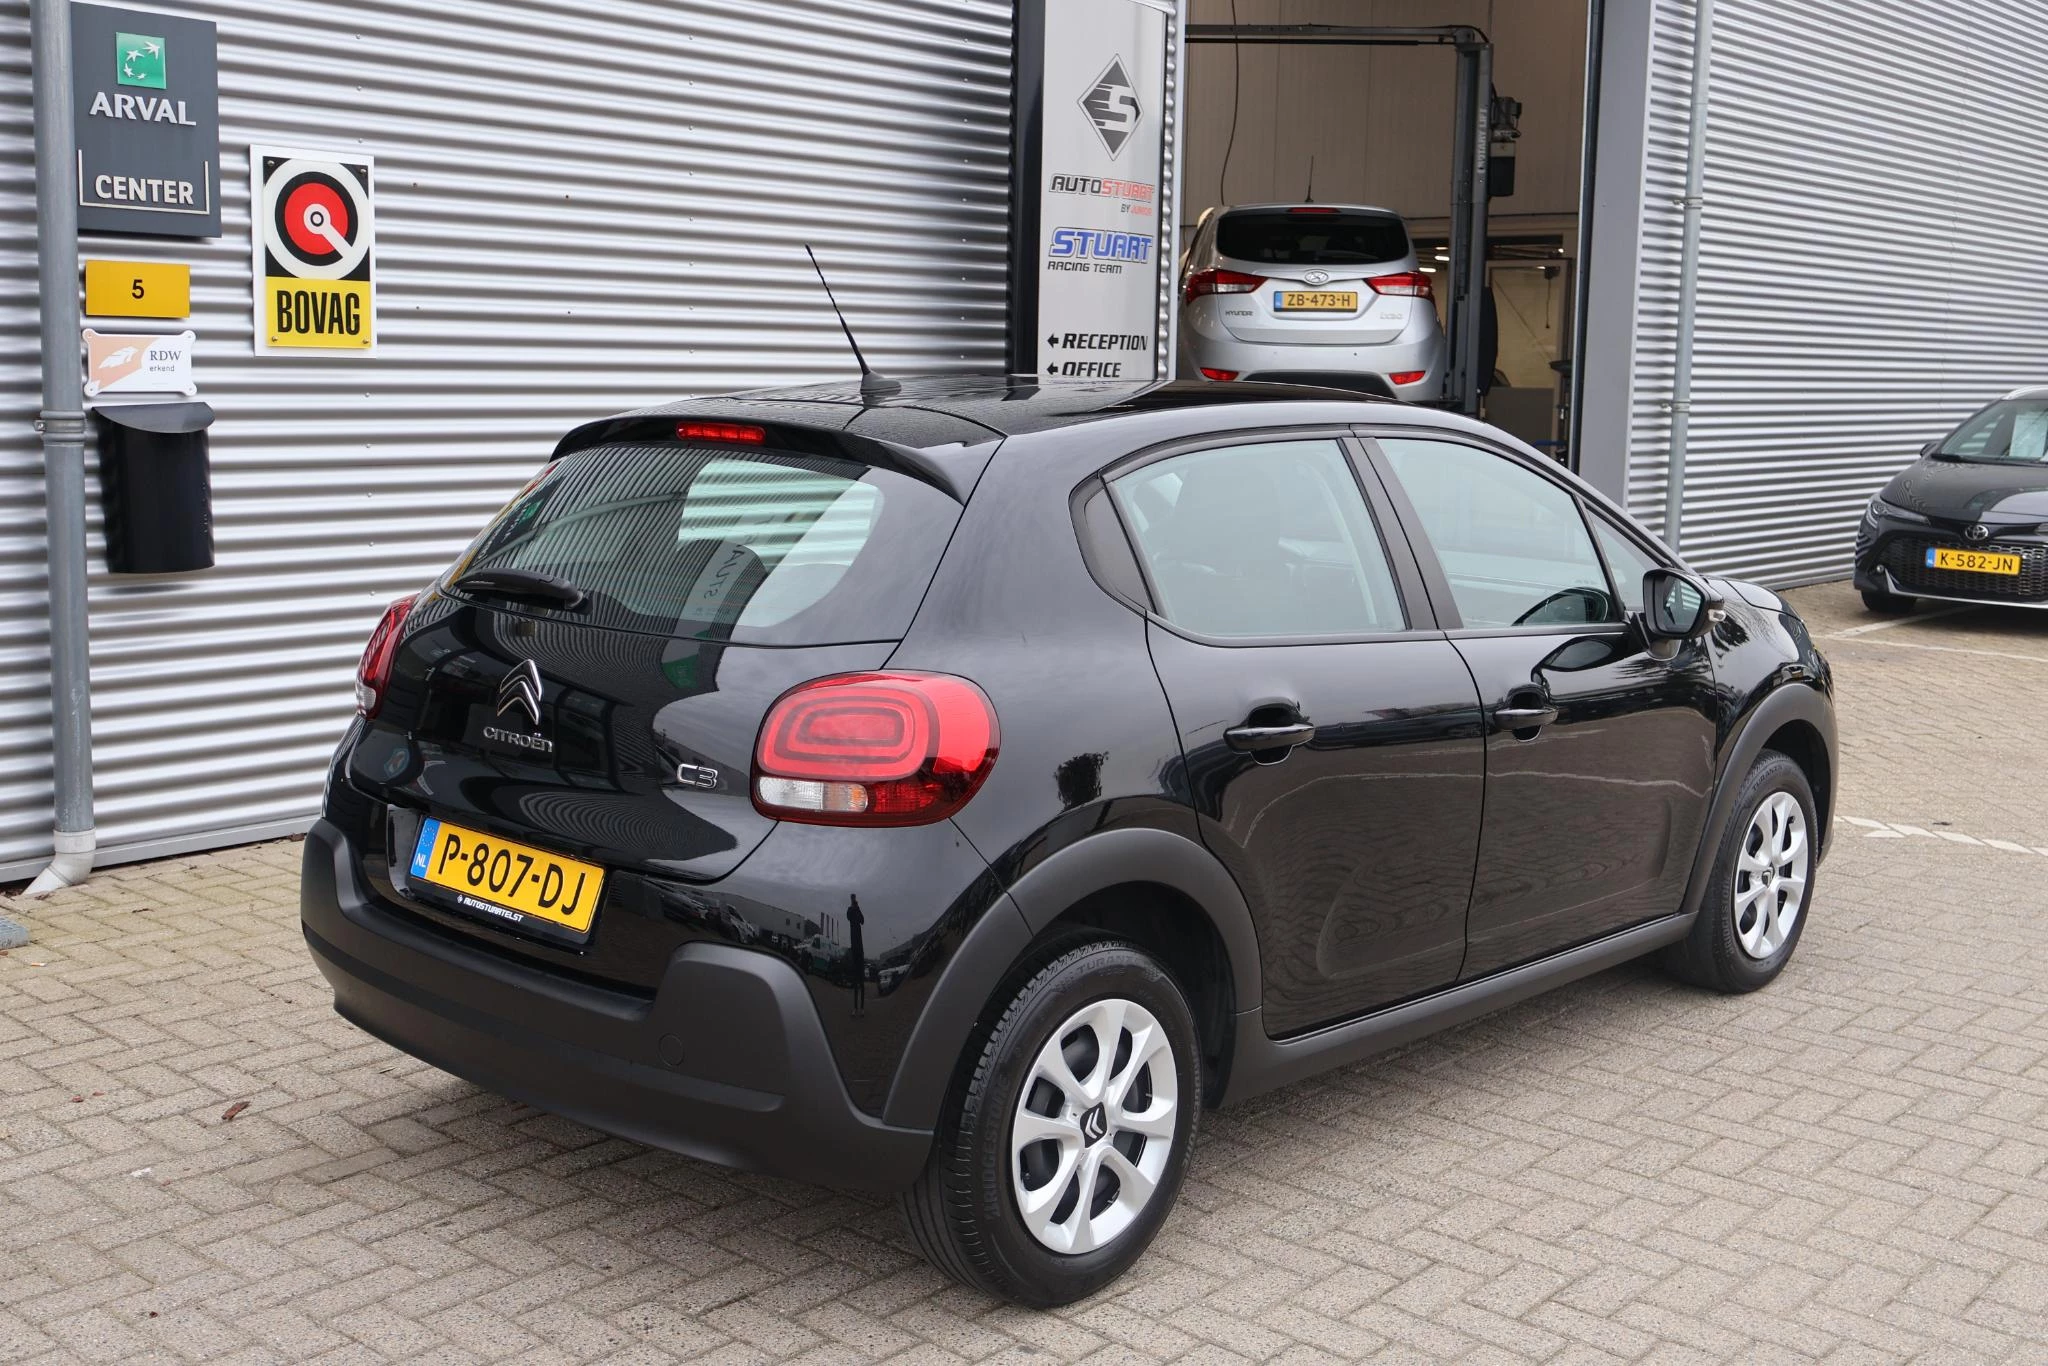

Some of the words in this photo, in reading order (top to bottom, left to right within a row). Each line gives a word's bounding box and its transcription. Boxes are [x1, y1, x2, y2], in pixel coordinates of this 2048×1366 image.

[89, 91, 197, 127] ARVAL
[94, 174, 195, 206] CENTER
[1050, 228, 1153, 262] STUART
[1047, 261, 1090, 272] RACING
[1093, 264, 1122, 274] TEAM
[131, 279, 145, 299] 5
[1287, 294, 1351, 307] ZB-473-H
[276, 290, 361, 336] BOVAG
[1062, 333, 1148, 351] RECEPTION
[150, 350, 182, 361] RDW
[1062, 362, 1121, 378] OFFICE
[1940, 552, 2013, 571] K-582-JN
[676, 763, 718, 788] C3
[415, 854, 426, 868] NL
[438, 833, 587, 916] P-807-DJ
